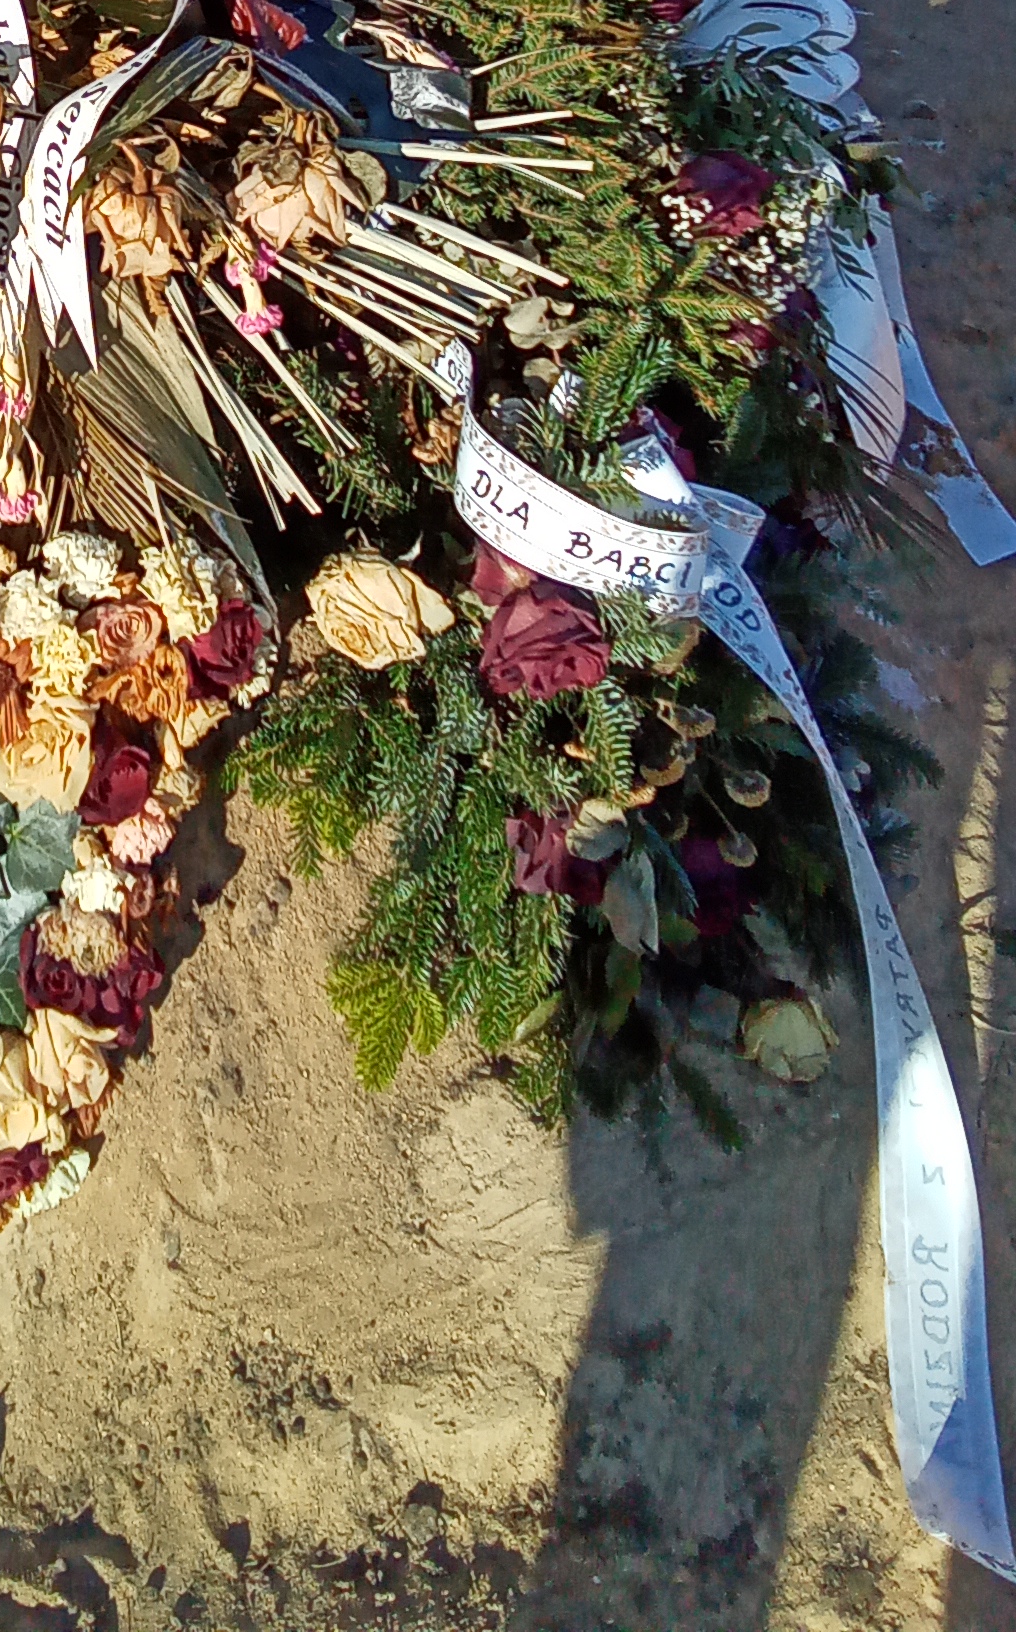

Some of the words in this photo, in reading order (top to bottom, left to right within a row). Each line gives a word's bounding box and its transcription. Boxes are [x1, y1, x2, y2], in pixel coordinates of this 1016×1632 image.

[470, 467, 531, 531] DLA
[563, 530, 694, 590] BABCI
[711, 580, 764, 634] OD
